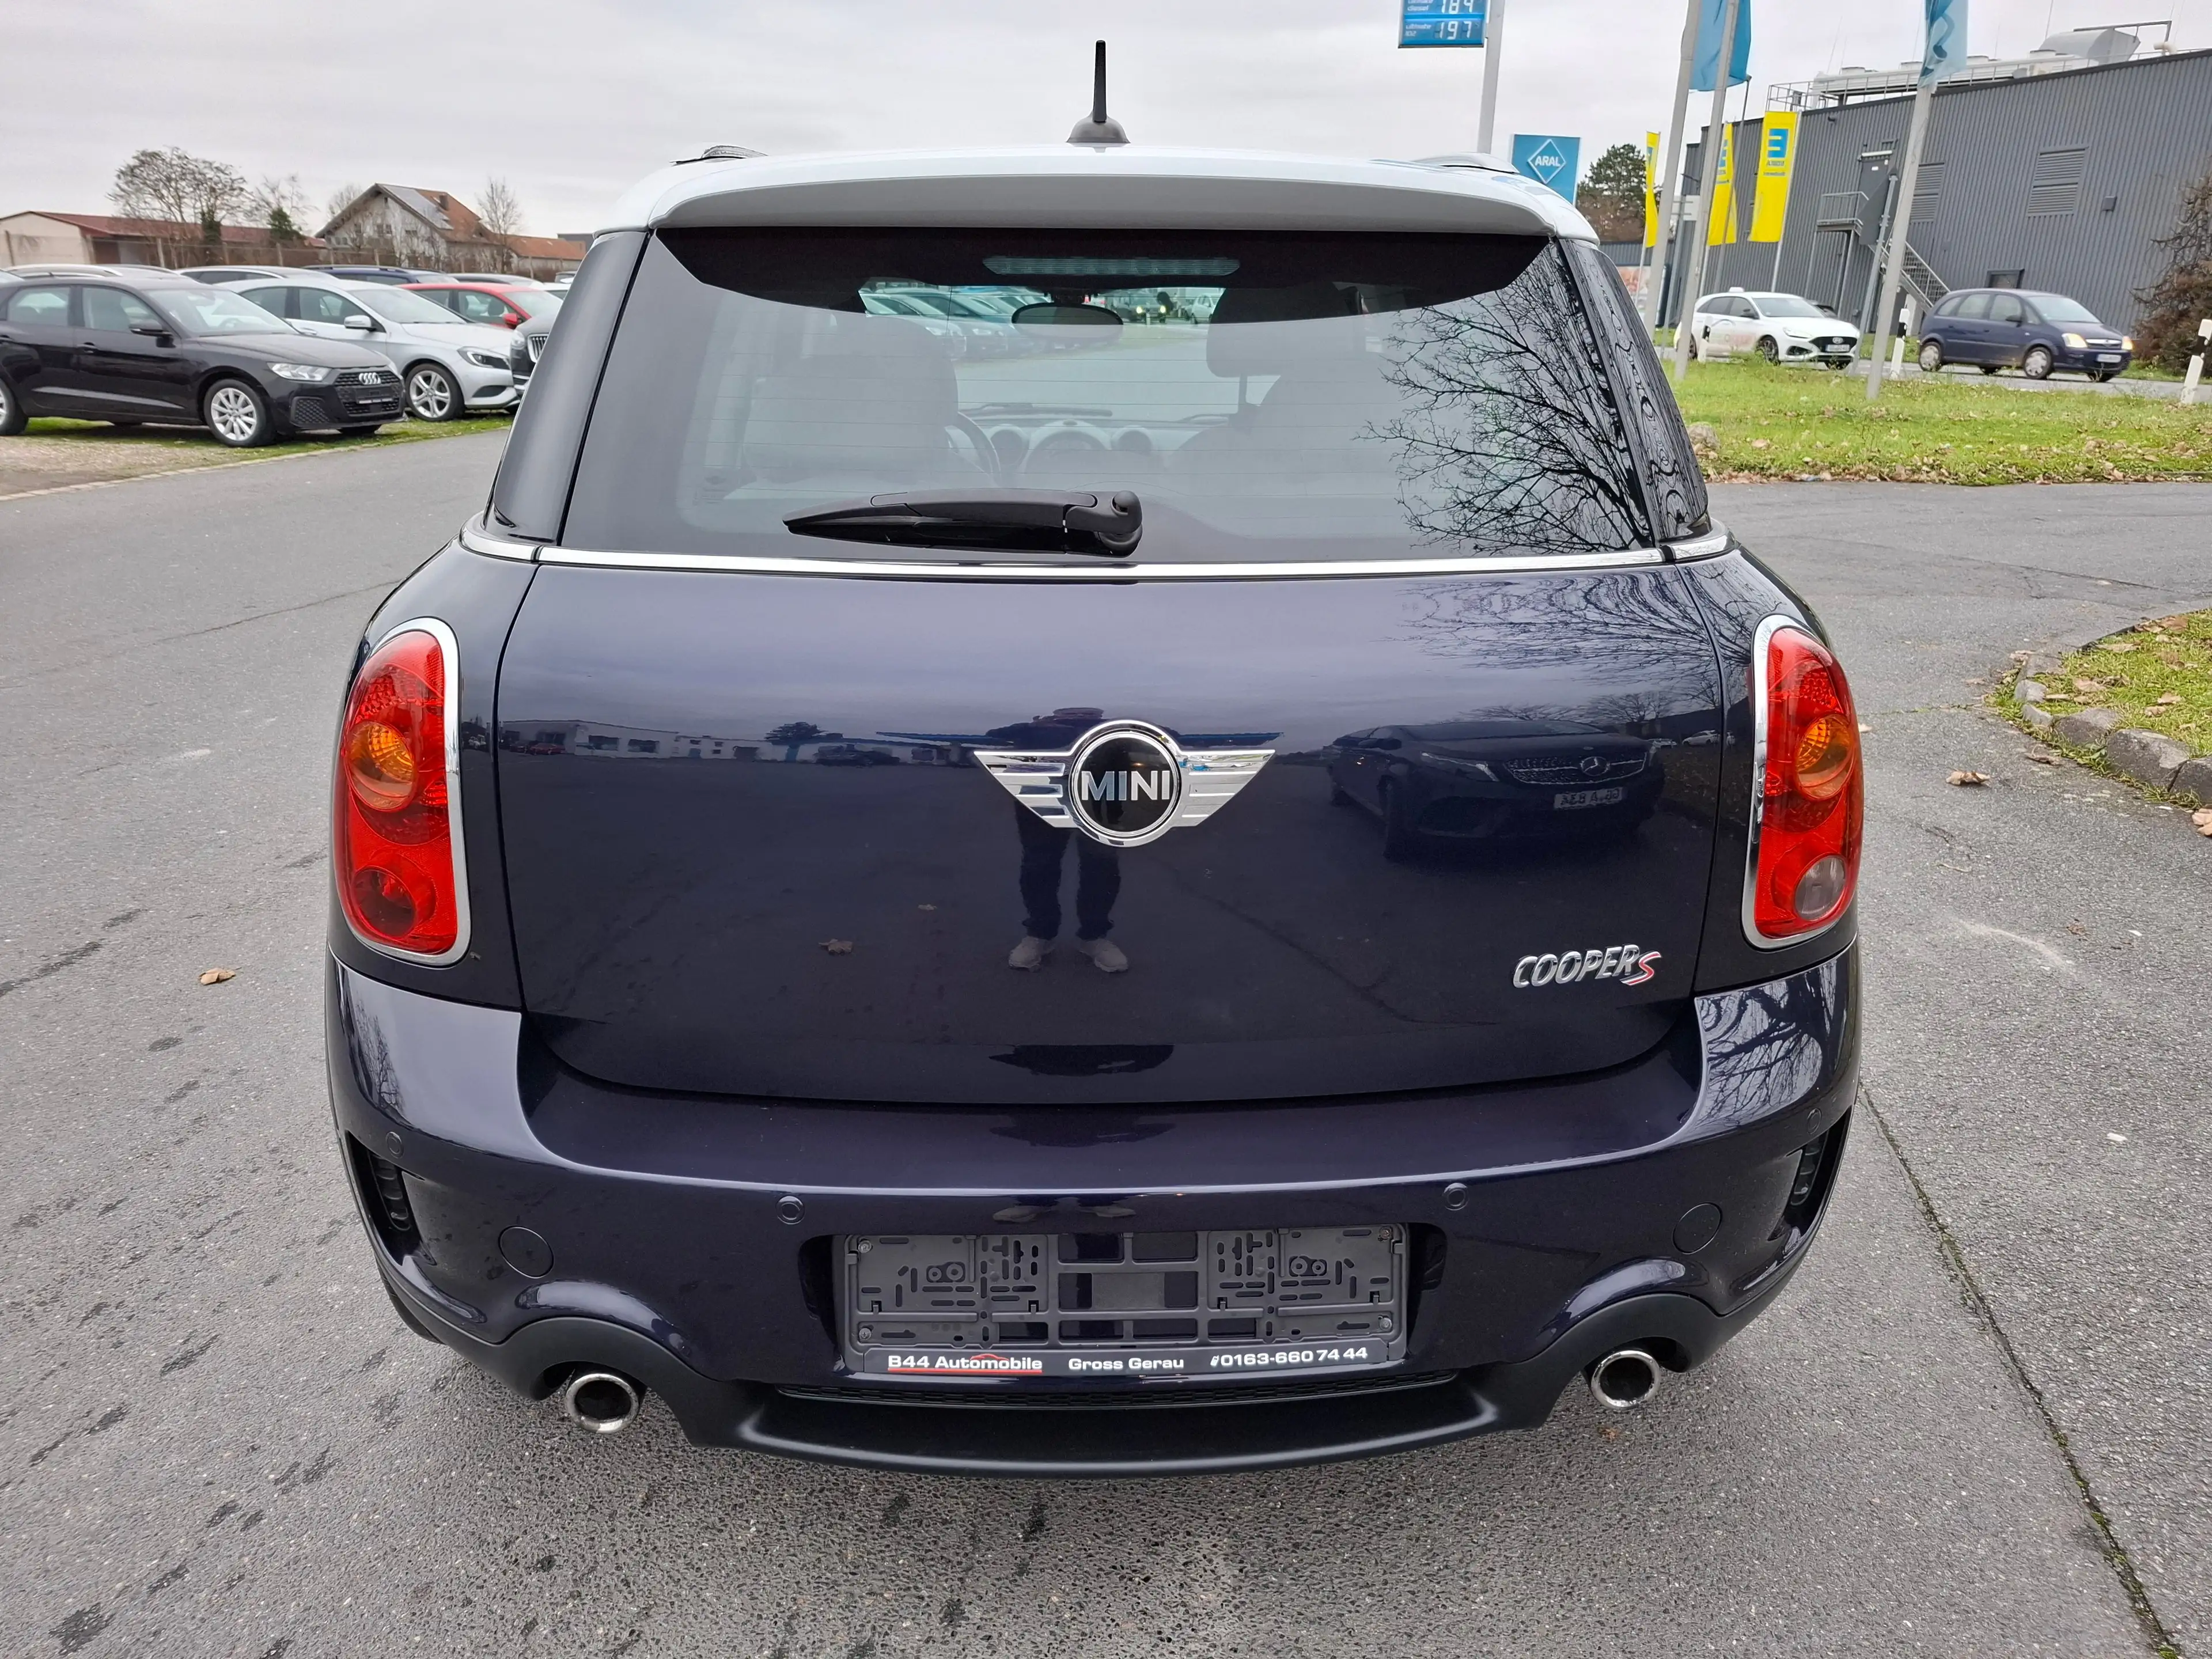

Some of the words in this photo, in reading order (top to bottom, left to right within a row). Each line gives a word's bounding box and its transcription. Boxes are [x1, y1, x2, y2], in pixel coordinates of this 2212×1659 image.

[1440, 21, 1472, 40] 197
[1535, 156, 1560, 166] ARAL
[1081, 770, 1170, 801] MINI
[1512, 943, 1639, 988] COOPER
[1620, 951, 1662, 986] S
[888, 1355, 930, 1368] B44
[935, 1356, 1043, 1370] Automobile
[1069, 1358, 1123, 1370] Gross
[1128, 1358, 1184, 1370] Gerau
[1220, 1350, 1313, 1366] 0163-660
[1316, 1349, 1339, 1361] 74
[1343, 1347, 1368, 1359] 44
